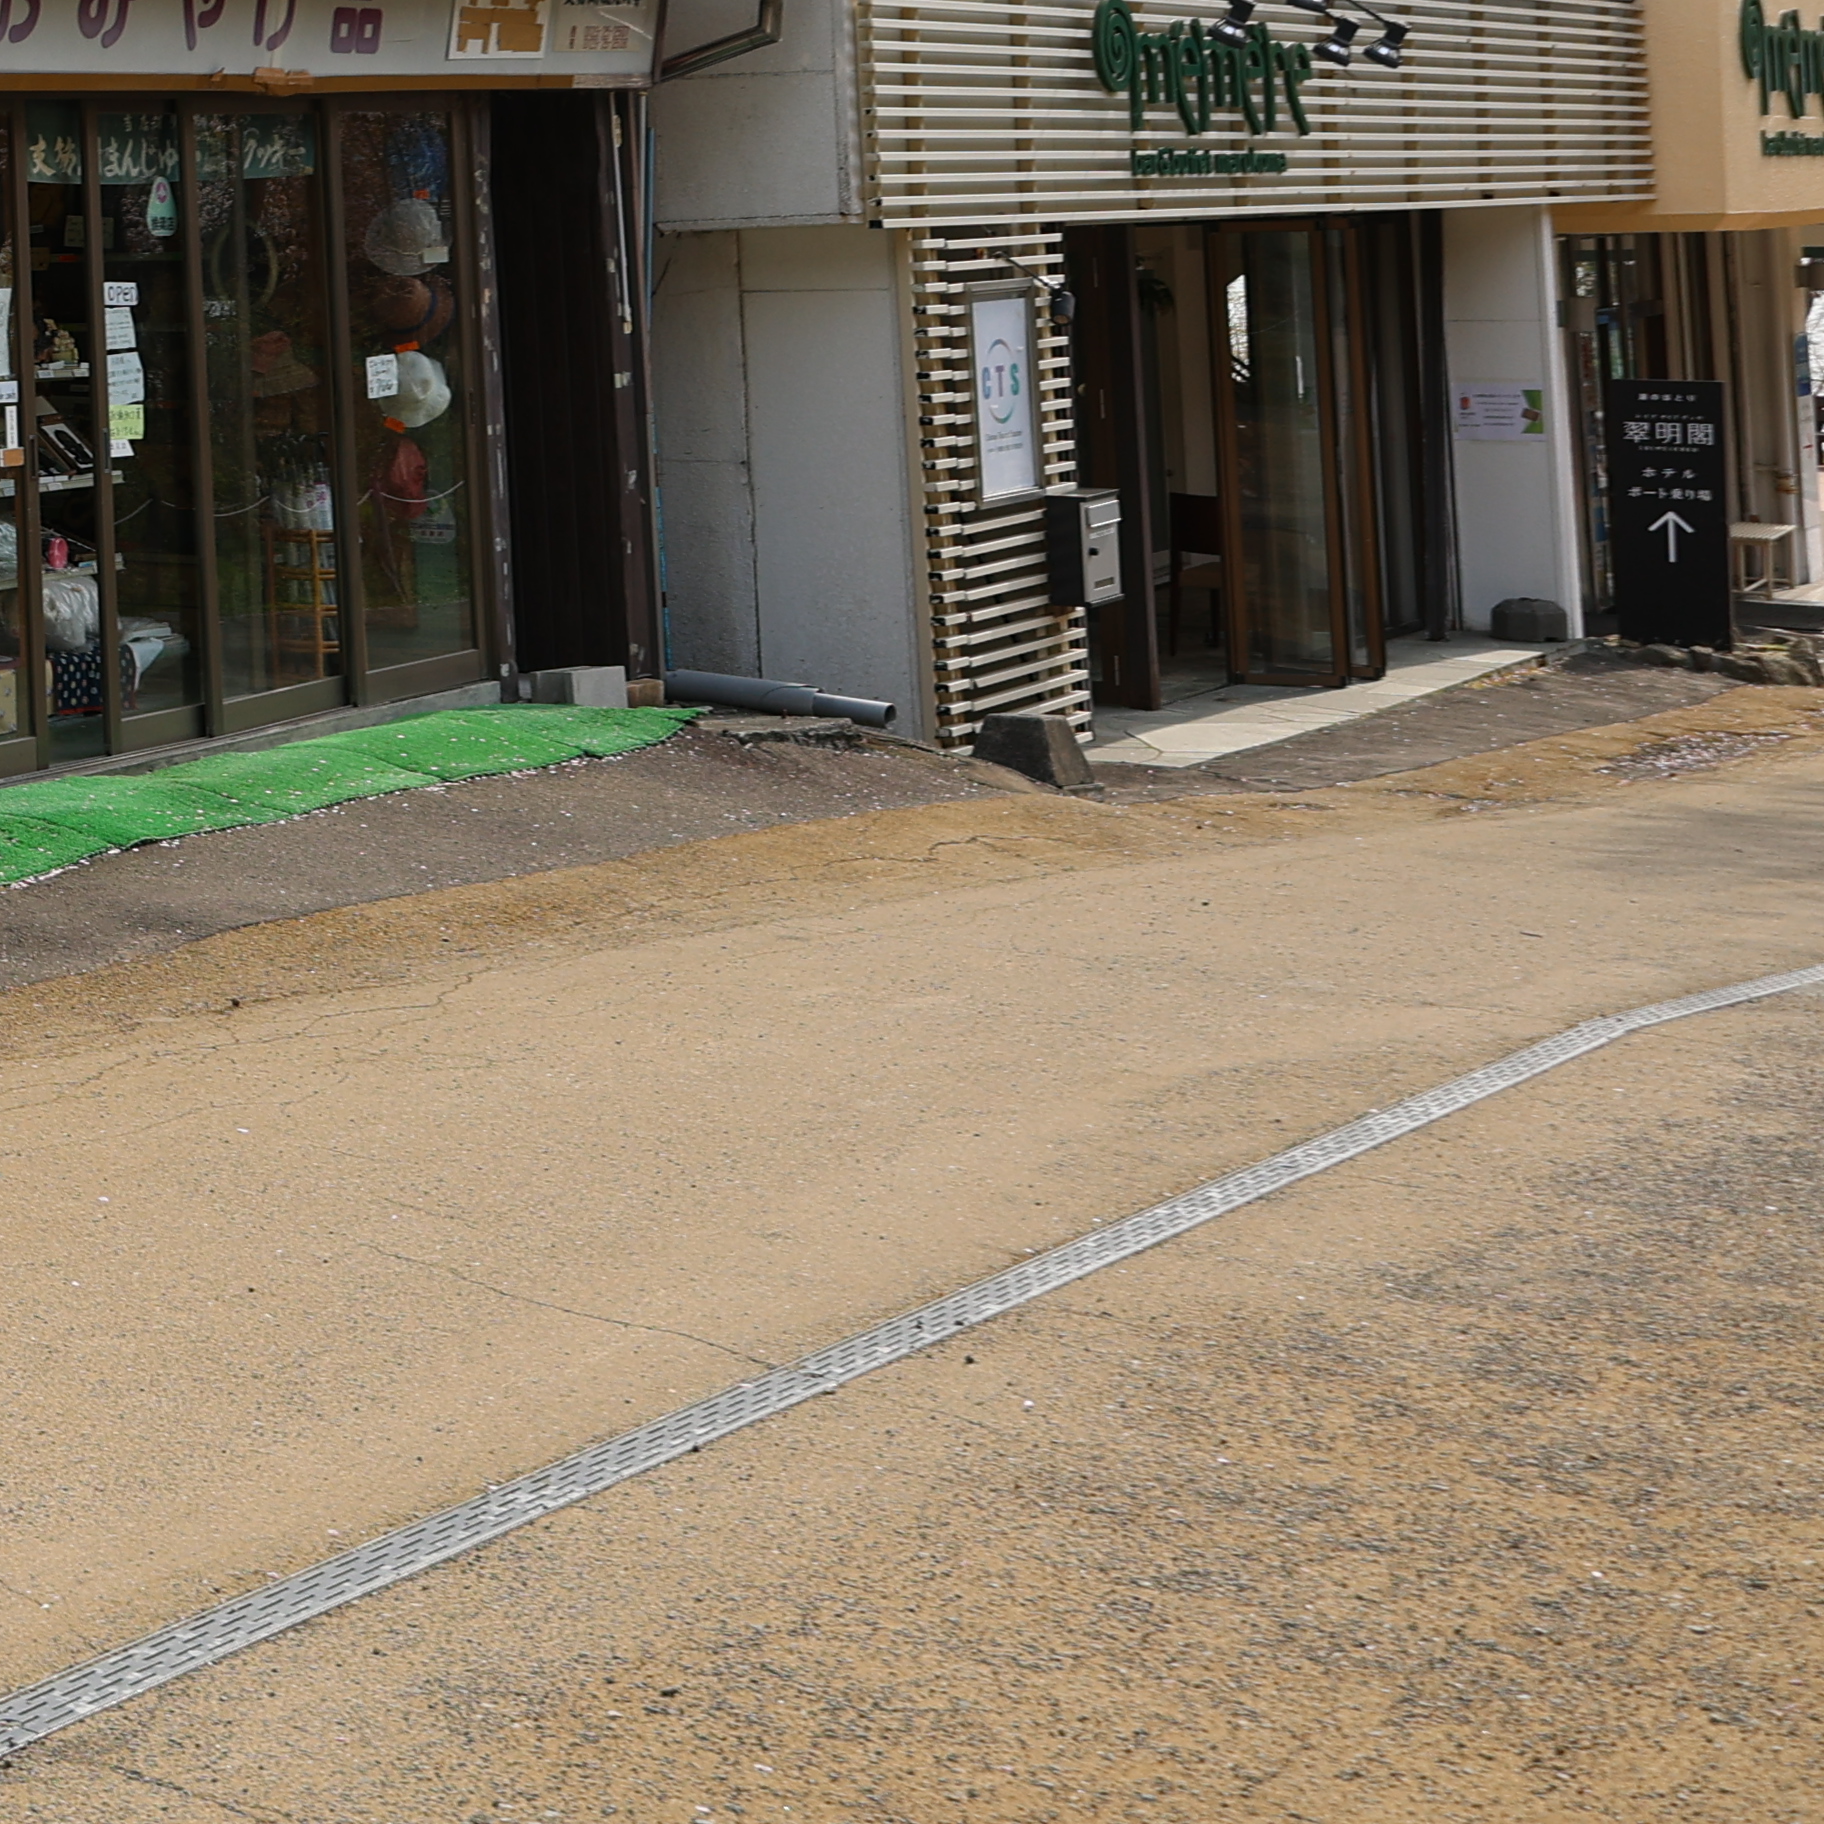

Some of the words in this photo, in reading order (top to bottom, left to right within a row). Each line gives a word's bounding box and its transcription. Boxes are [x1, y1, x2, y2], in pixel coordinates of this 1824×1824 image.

[982, 363, 1020, 399] CTS
[1622, 421, 1714, 445] 翠明閣
